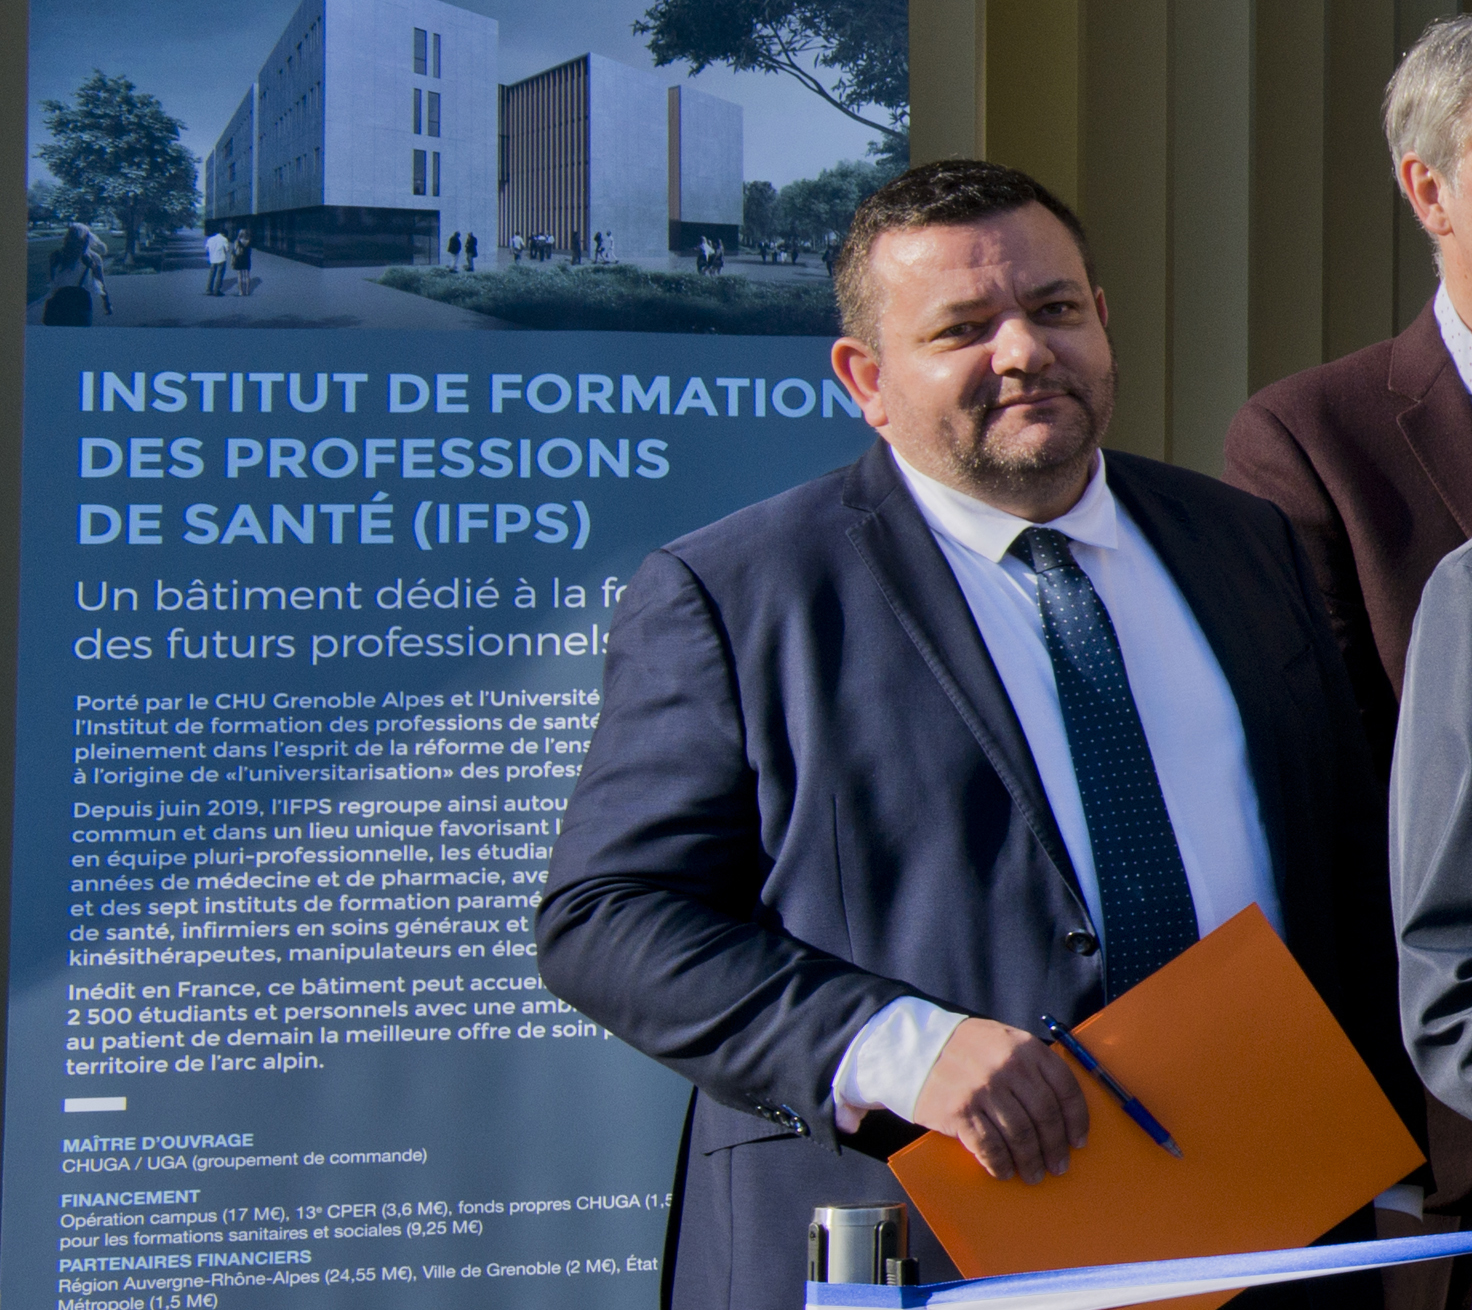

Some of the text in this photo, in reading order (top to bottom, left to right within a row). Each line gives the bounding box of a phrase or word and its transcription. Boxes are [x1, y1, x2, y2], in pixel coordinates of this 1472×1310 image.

[83, 371, 368, 413] INSTITUT
[390, 373, 469, 413] DE
[81, 438, 669, 478] DES PROFESSIONS
[80, 491, 590, 550] DE SANTÉ (IFPS)
[78, 580, 138, 611] Un
[157, 579, 362, 611] bâtiment
[377, 577, 499, 610] dédié
[515, 577, 536, 609] à
[554, 577, 585, 609] la
[75, 627, 152, 660] des
[168, 626, 295, 659] futurs
[77, 694, 139, 711] Porté
[146, 698, 182, 714] par
[190, 693, 209, 710] le
[216, 693, 265, 710] CHU
[273, 692, 376, 709] Grenoble
[382, 690, 444, 710] Alpes
[451, 691, 473, 707] et
[175, 717, 204, 734] de
[211, 716, 322, 734] formation
[330, 716, 369, 732] des
[377, 714, 503, 736] professions
[509, 713, 537, 731] de
[75, 742, 206, 764] pleinement
[214, 742, 267, 759] dans
[356, 740, 383, 756] de
[391, 739, 408, 756] la
[416, 738, 504, 756] réforme
[511, 737, 538, 755] de
[74, 767, 86, 784] à
[191, 766, 219, 783] de
[461, 761, 499, 779] des
[74, 800, 153, 821] Depuis
[157, 799, 200, 821] juin
[208, 799, 264, 817] 2019,
[339, 799, 442, 818] regroupe
[448, 795, 497, 812] ainsi
[71, 900, 93, 916] et
[101, 900, 141, 916] des
[149, 898, 198, 918] sept
[206, 896, 297, 914] instituts
[304, 895, 333, 912] de
[340, 893, 450, 911] formation
[70, 916, 529, 941] de santé, infirmiers en soins généraux et
[70, 946, 281, 967] kinésithérapeutes,
[290, 942, 451, 964] manipulateurs
[458, 944, 485, 958] en
[66, 1056, 168, 1075] territoire
[175, 1055, 204, 1073] de
[263, 1052, 324, 1073] alpin.
[62, 1189, 201, 1207] FINANCEMENT
[60, 1249, 312, 1272] PARTENAIRES FINANCIERS
